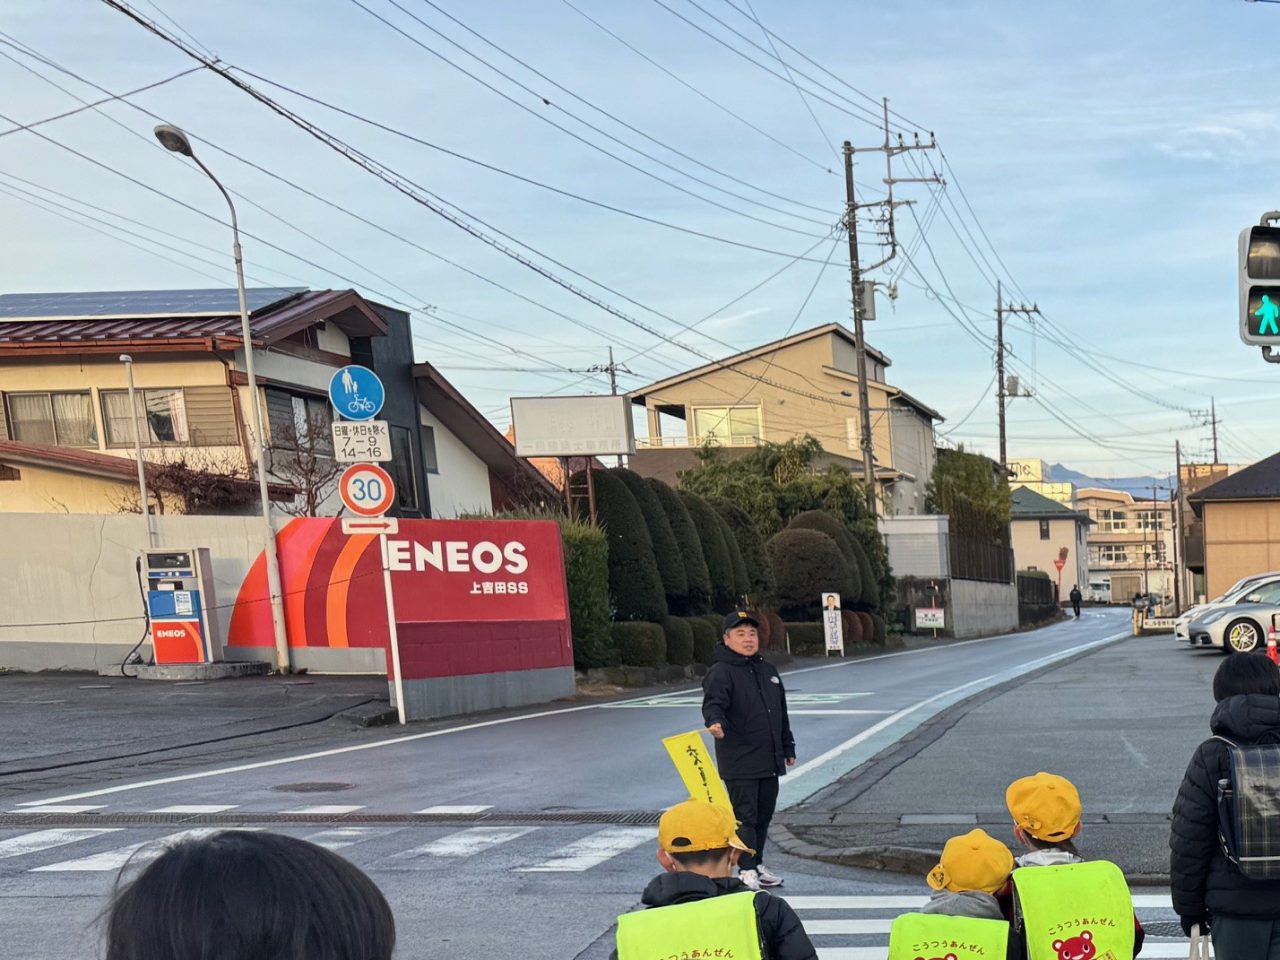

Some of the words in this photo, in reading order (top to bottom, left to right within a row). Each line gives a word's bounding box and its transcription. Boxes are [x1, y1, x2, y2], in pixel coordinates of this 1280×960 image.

[334, 425, 386, 437] 日曜・休日を除く
[352, 478, 382, 501] 30
[387, 540, 529, 574] ENEOS
[469, 581, 529, 595] 上吉田SS
[156, 629, 186, 638] ENEOS
[1048, 917, 1116, 936] こうつうあんぜん
[912, 940, 985, 956] こうつうあんぜん
